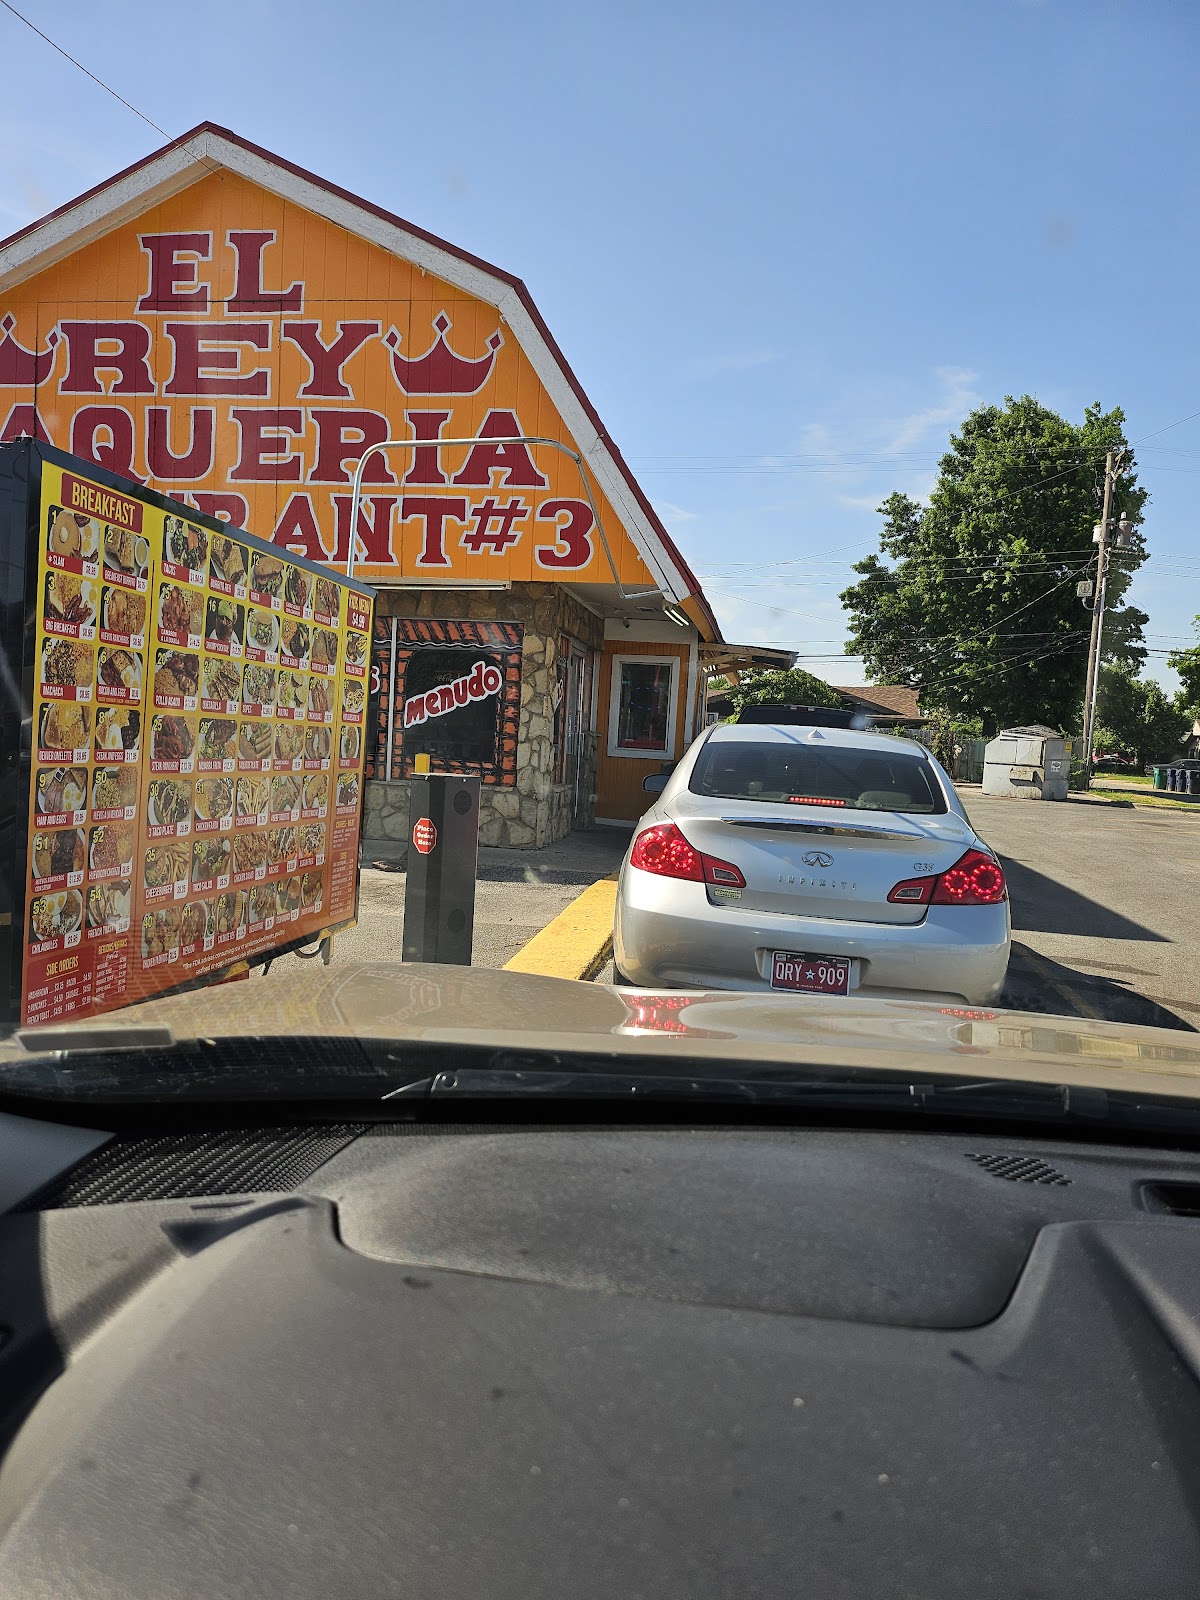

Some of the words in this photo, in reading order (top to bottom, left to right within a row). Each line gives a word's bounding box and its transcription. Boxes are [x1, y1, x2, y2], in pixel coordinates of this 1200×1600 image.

[135, 229, 305, 316] EL
[57, 320, 383, 399] REY
[72, 482, 135, 526] BREAKFAST
[52, 510, 57, 525] 1
[108, 530, 113, 543] 2
[253, 554, 260, 566] 12
[164, 563, 176, 576] TACOS
[48, 576, 55, 591] 3
[104, 591, 110, 604] 4
[209, 600, 216, 612] 16
[352, 612, 365, 628] $4.99
[54, 622, 77, 635] BREAKFAST
[45, 642, 52, 655] 5
[101, 651, 106, 663] 6
[155, 695, 168, 705] POLLO
[404, 661, 502, 728] Menudo
[43, 708, 49, 720] 7
[99, 712, 105, 723] 8
[154, 719, 162, 731] 25
[40, 774, 46, 787] 9
[96, 771, 107, 783] 50
[150, 784, 159, 796] 30
[37, 816, 47, 826] HAM
[93, 831, 104, 843] 52
[36, 837, 48, 851] 51
[147, 849, 156, 862] 35
[778, 875, 856, 890] INFINITI
[90, 889, 102, 902] 54
[33, 899, 46, 914] 53
[144, 916, 152, 929] 40
[88, 927, 103, 939] FRENCH
[32, 939, 58, 954] CHILAQUILES
[183, 944, 195, 956] MENUDO
[46, 963, 58, 976] SIDE
[59, 955, 79, 974] ORDERS
[196, 966, 210, 975] seafood
[776, 962, 802, 981] QRY
[818, 967, 844, 986] 909
